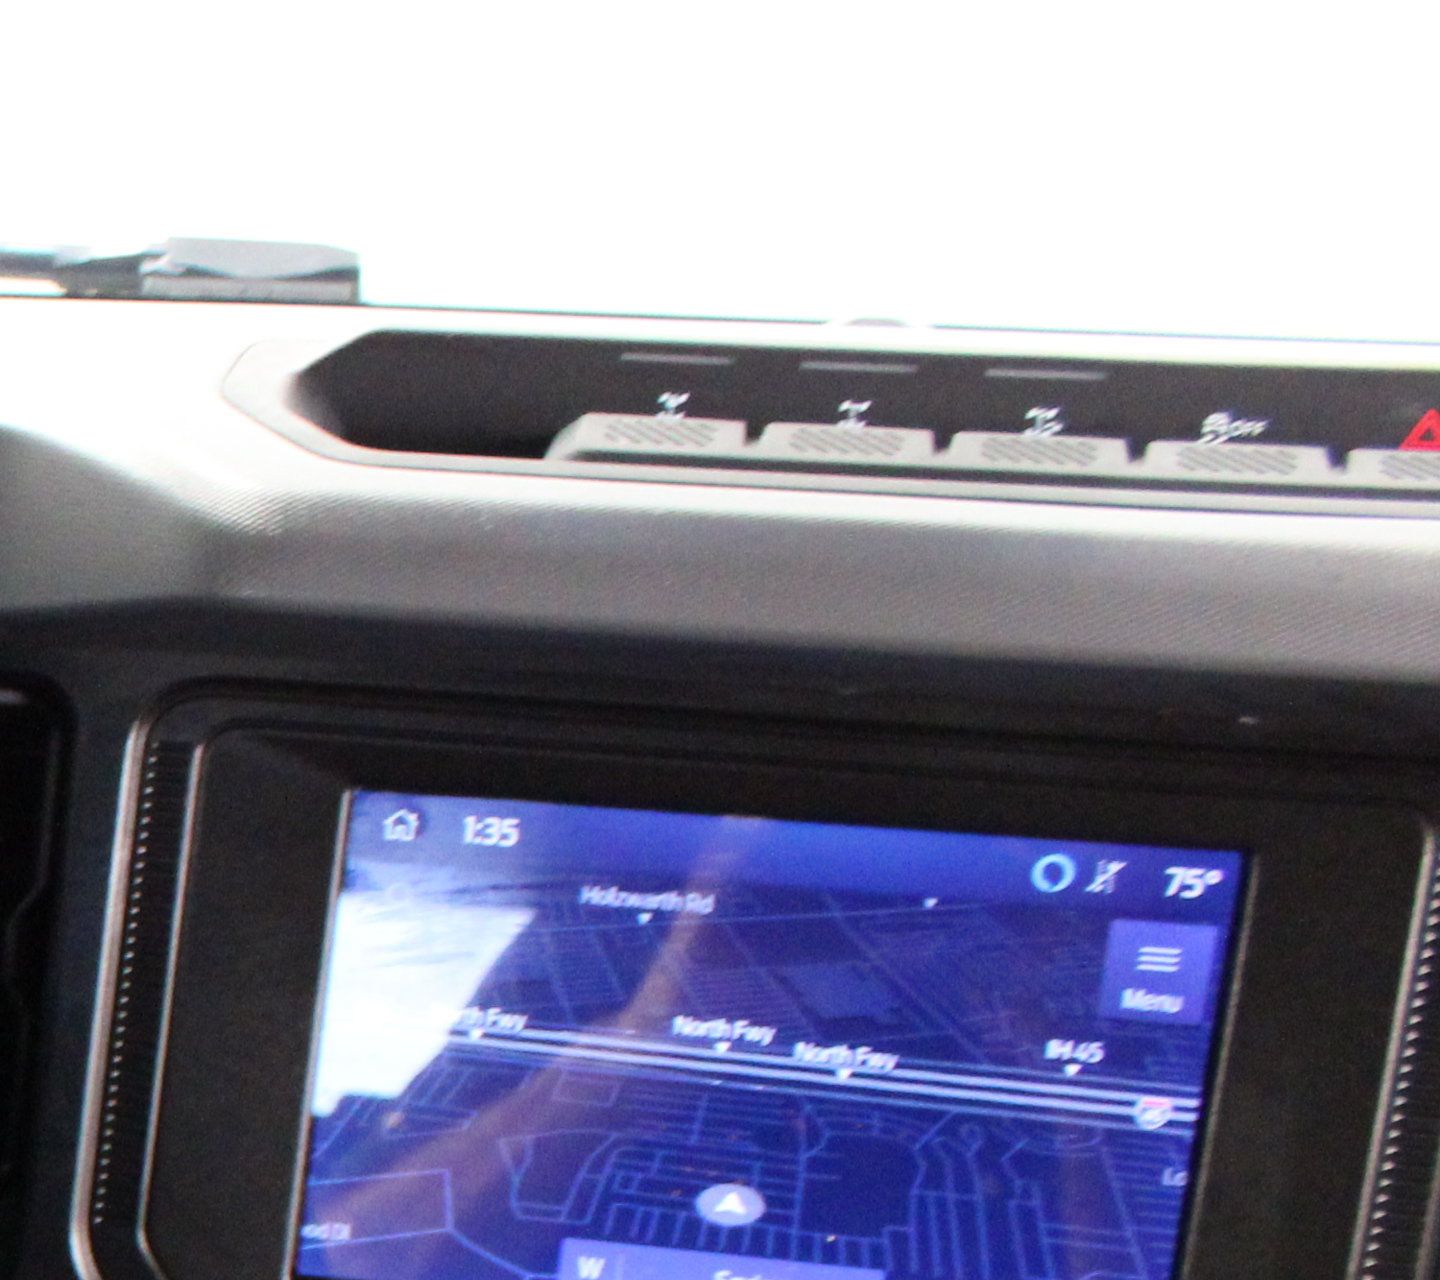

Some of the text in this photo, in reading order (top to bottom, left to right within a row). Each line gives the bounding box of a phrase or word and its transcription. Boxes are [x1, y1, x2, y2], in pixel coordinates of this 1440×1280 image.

[461, 815, 521, 848] 1:35
[684, 893, 715, 916] Rd
[1120, 988, 1183, 1014] Menu
[672, 1014, 778, 1047] North Fwy
[794, 1040, 900, 1073] North Fwy
[577, 1255, 605, 1280] W
